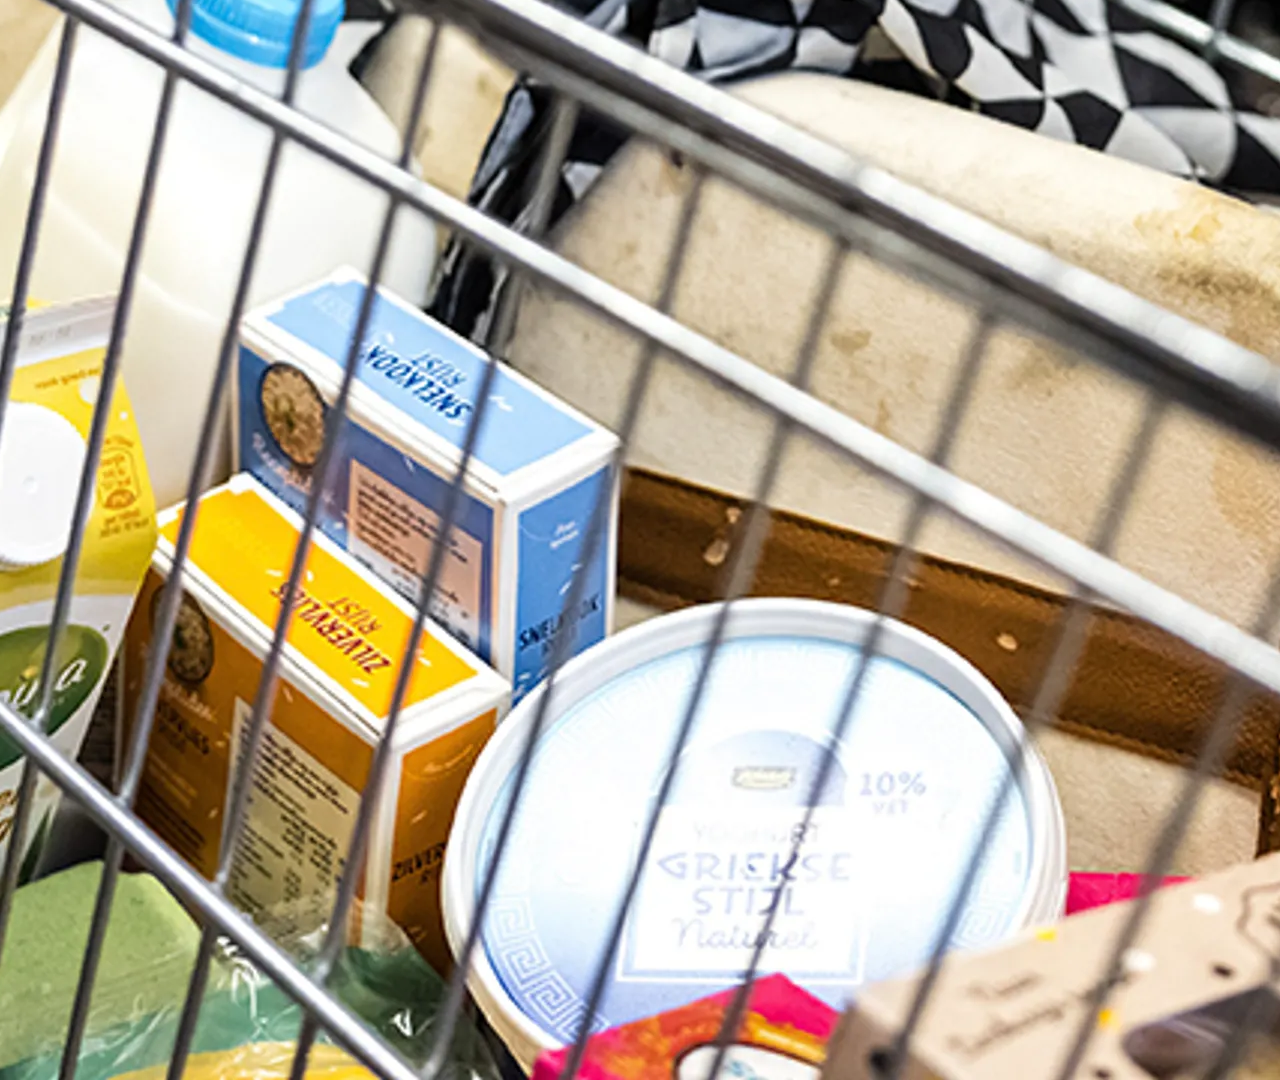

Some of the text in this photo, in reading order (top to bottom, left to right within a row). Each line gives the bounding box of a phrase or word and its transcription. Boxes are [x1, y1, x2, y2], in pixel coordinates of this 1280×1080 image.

[860, 771, 927, 796] 10%
[872, 800, 910, 815] VET
[657, 852, 852, 882] GRIEKSE
[693, 885, 805, 916] STIJL
